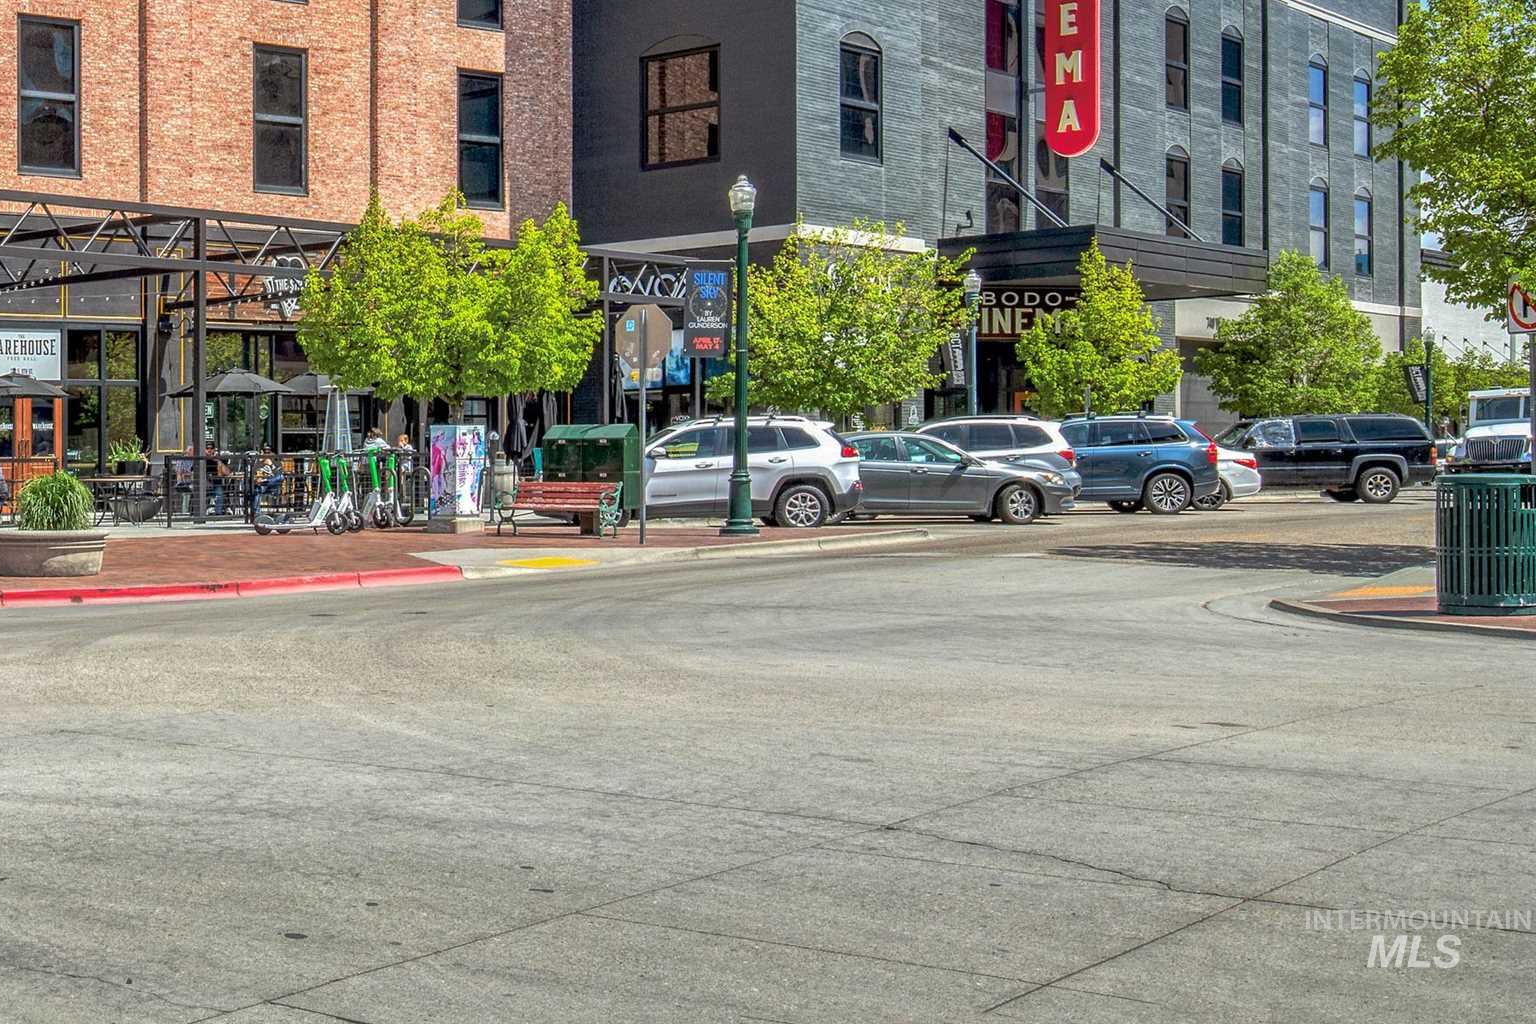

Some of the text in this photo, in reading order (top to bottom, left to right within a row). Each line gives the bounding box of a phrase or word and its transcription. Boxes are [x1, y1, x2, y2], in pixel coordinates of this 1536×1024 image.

[693, 272, 726, 285] SILENT
[699, 287, 720, 298] SKY
[982, 291, 1062, 306] BODO
